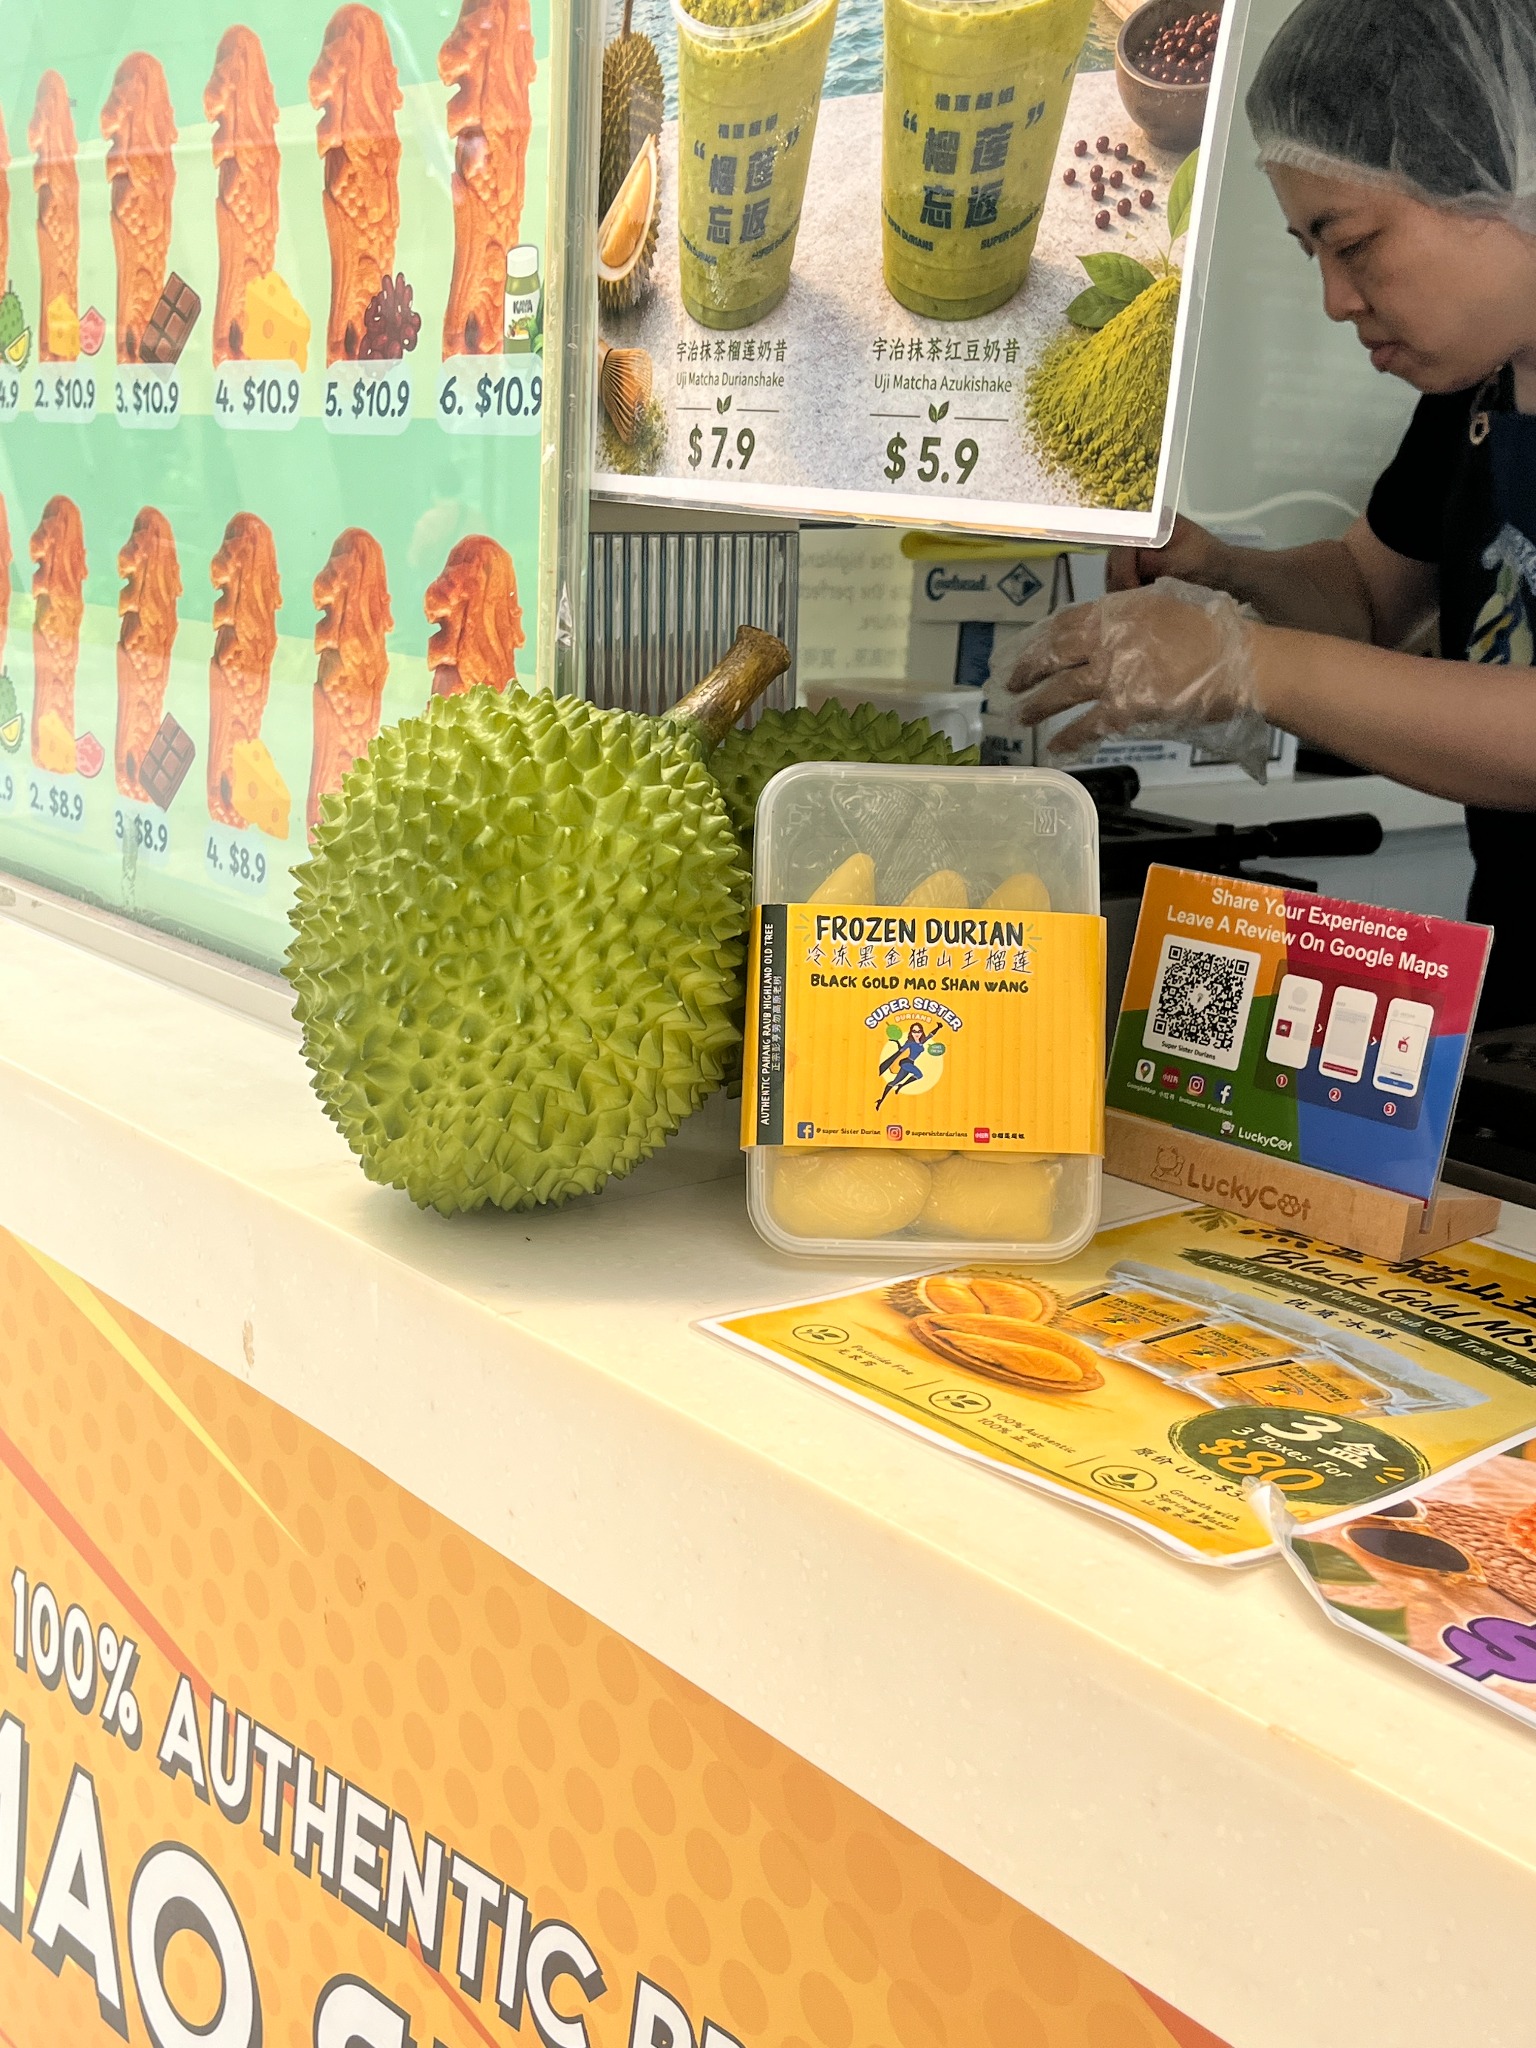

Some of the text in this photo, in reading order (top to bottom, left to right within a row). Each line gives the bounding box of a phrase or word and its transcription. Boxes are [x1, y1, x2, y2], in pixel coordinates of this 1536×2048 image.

[706, 197, 771, 245] 忘返
[919, 178, 1004, 229] 忘返
[676, 339, 788, 363] 宇治抹茶榴莲奶昔
[872, 336, 1021, 364] 宇治抹茶红豆奶昔
[35, 377, 95, 410] 2. $10.9
[115, 378, 179, 415] 3. $10.9
[215, 376, 299, 414] 4. $10.9
[325, 377, 410, 419] 5. $10.9
[440, 372, 542, 418] 6. $10.9
[676, 371, 785, 388] Uji Matcha Durianshake
[874, 373, 1012, 393] Uji Matcha Azukishake
[30, 782, 83, 822] 2. $8.9
[135, 814, 168, 853] $8.9
[206, 836, 266, 884] 4. $8.9
[816, 915, 1023, 947] FROZEN DURIAN
[1211, 887, 1408, 942] Share Your Experience
[805, 943, 1033, 974] 冷冻黑金猫山王榴莲
[1167, 905, 1448, 980] Leave A Review On Google Maps
[810, 973, 857, 987] BLACK
[862, 975, 900, 990] GOLD
[904, 977, 937, 991] MAO
[941, 976, 980, 992] SHAN
[760, 923, 774, 1126] AUTHENTIC PAHANG RAUB HIGHLAND OLD TREE
[864, 996, 963, 1032] SUPER SISTER
[894, 1013, 932, 1024] DURIANS
[1161, 1040, 1216, 1060] Super Sister Durians
[1199, 1255, 1536, 1379] Freshly Frozen Pahang Raub Old Tree Duria
[1245, 1248, 1536, 1354] Black Gold MS
[1284, 1298, 1398, 1340] 优质冰鲜
[892, 1364, 914, 1375] Free
[978, 1418, 1044, 1449] 100% 正宗
[993, 1413, 1076, 1454] 100% Authentic
[1231, 1426, 1352, 1478] 3 Boxes For
[1175, 1466, 1212, 1485] U.P.
[1198, 1438, 1325, 1491] $80
[1155, 1493, 1237, 1531] Spring Water
[1170, 1489, 1240, 1522] Growth with
[11, 1566, 607, 2048] 100% AUTHENTIC
